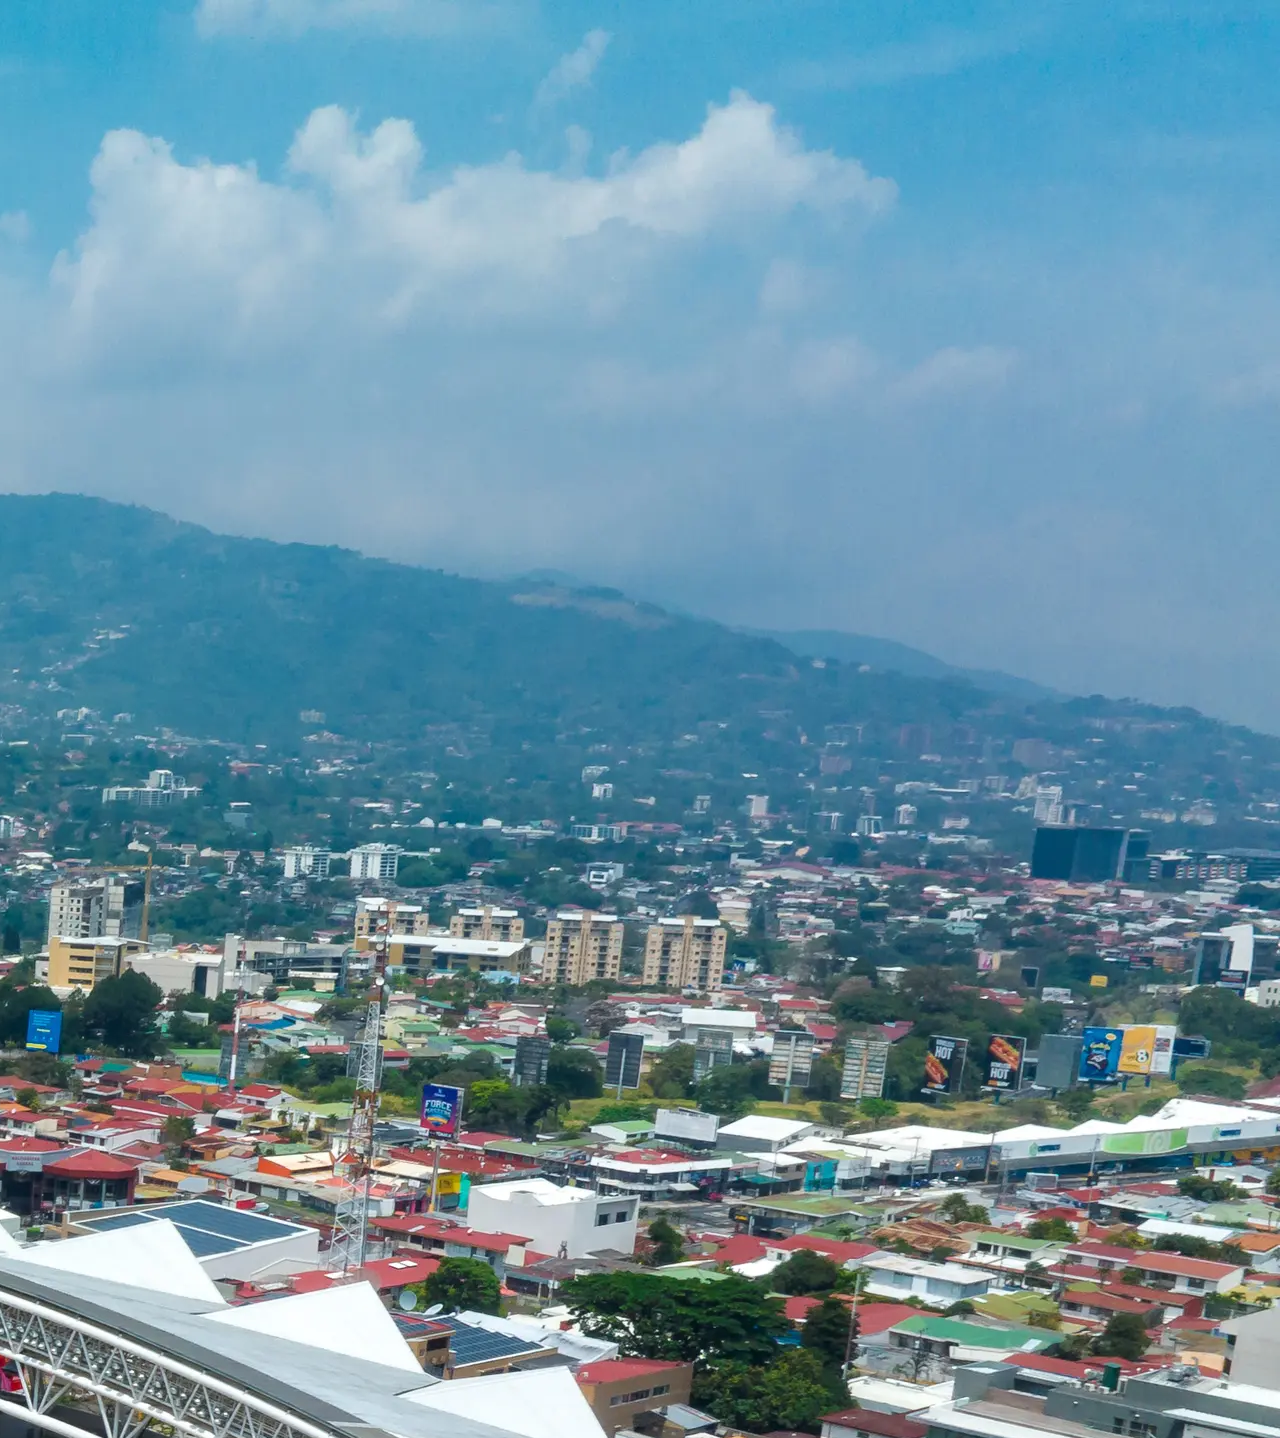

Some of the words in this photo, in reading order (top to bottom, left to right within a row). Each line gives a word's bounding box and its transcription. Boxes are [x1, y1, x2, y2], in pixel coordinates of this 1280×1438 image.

[934, 1046, 953, 1060] HOT
[990, 1067, 1010, 1080] HOT
[425, 1099, 452, 1112] FORCE
